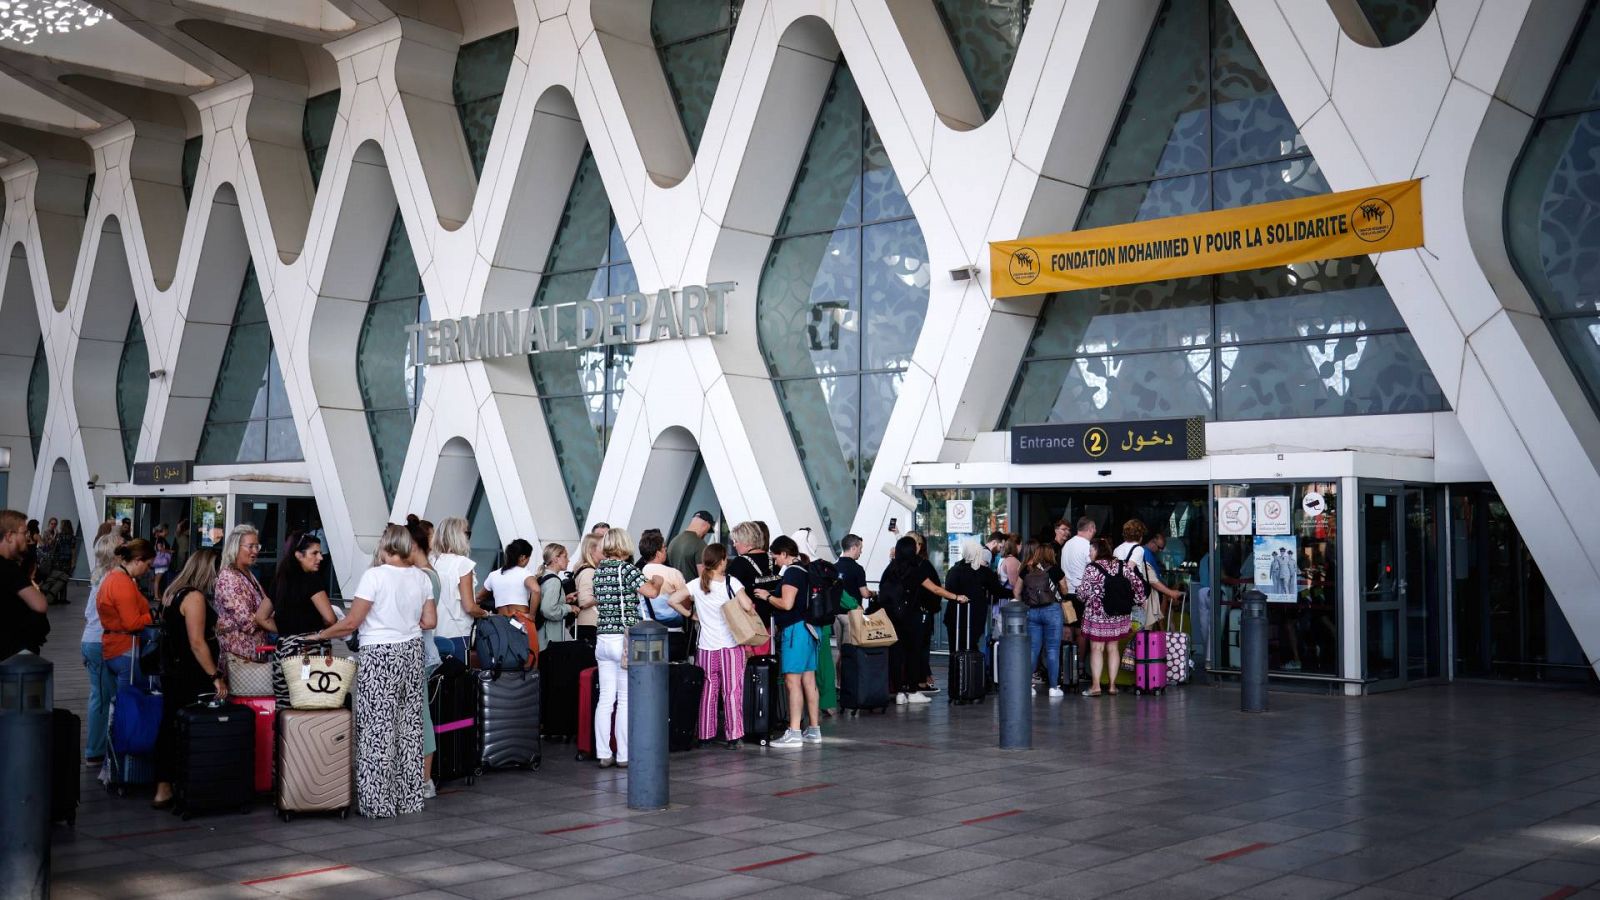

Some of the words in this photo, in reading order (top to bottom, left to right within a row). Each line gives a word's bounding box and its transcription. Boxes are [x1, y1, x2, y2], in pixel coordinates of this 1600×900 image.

[1051, 247, 1116, 272] FONDATION
[1118, 238, 1189, 264] MOHAMMED
[1193, 235, 1202, 254] V
[1206, 230, 1242, 253] POUR
[1245, 227, 1263, 248] LA
[1266, 214, 1348, 244] SOLIDARITE
[404, 302, 577, 366] TERMINAL
[576, 281, 735, 348] DEPART
[1020, 436, 1075, 449] Entrance
[1090, 432, 1101, 451] 2
[1121, 430, 1173, 451] دخول
